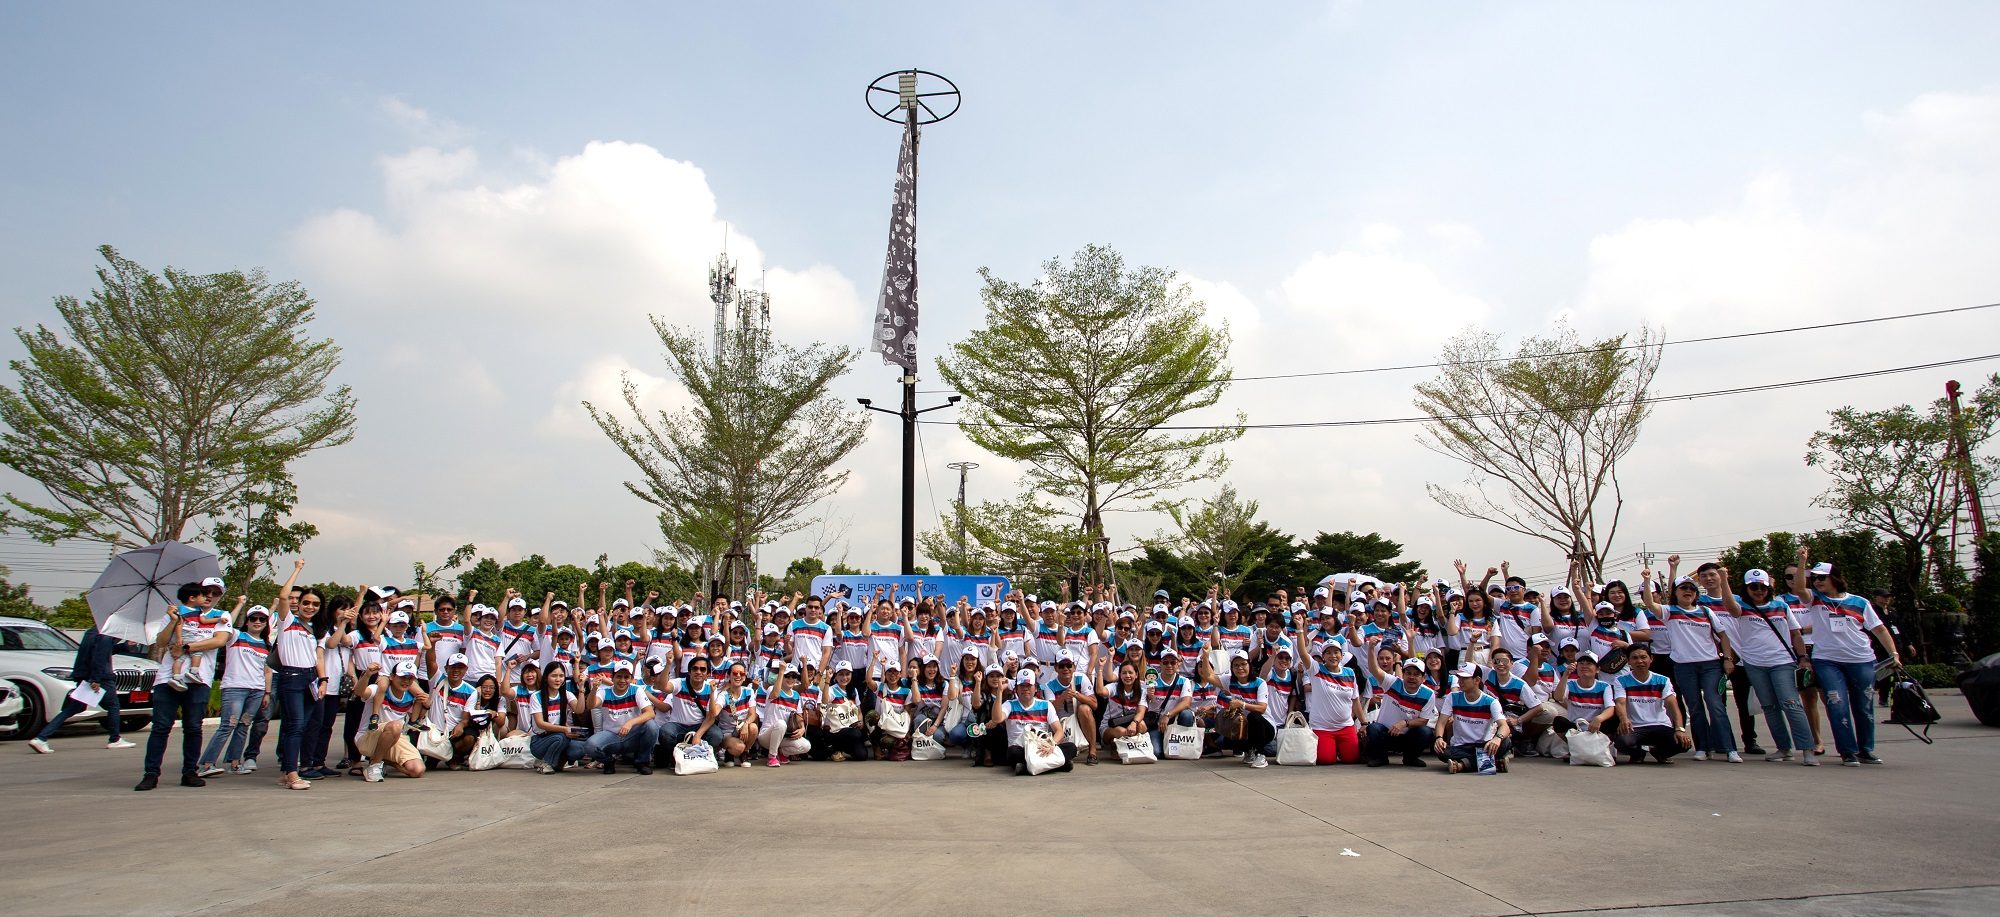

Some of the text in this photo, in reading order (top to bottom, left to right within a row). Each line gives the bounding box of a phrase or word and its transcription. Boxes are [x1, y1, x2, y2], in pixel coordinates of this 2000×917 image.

[857, 583, 938, 593] EUROP MOOR
[916, 739, 934, 748] BM
[1171, 733, 1195, 744] BMW
